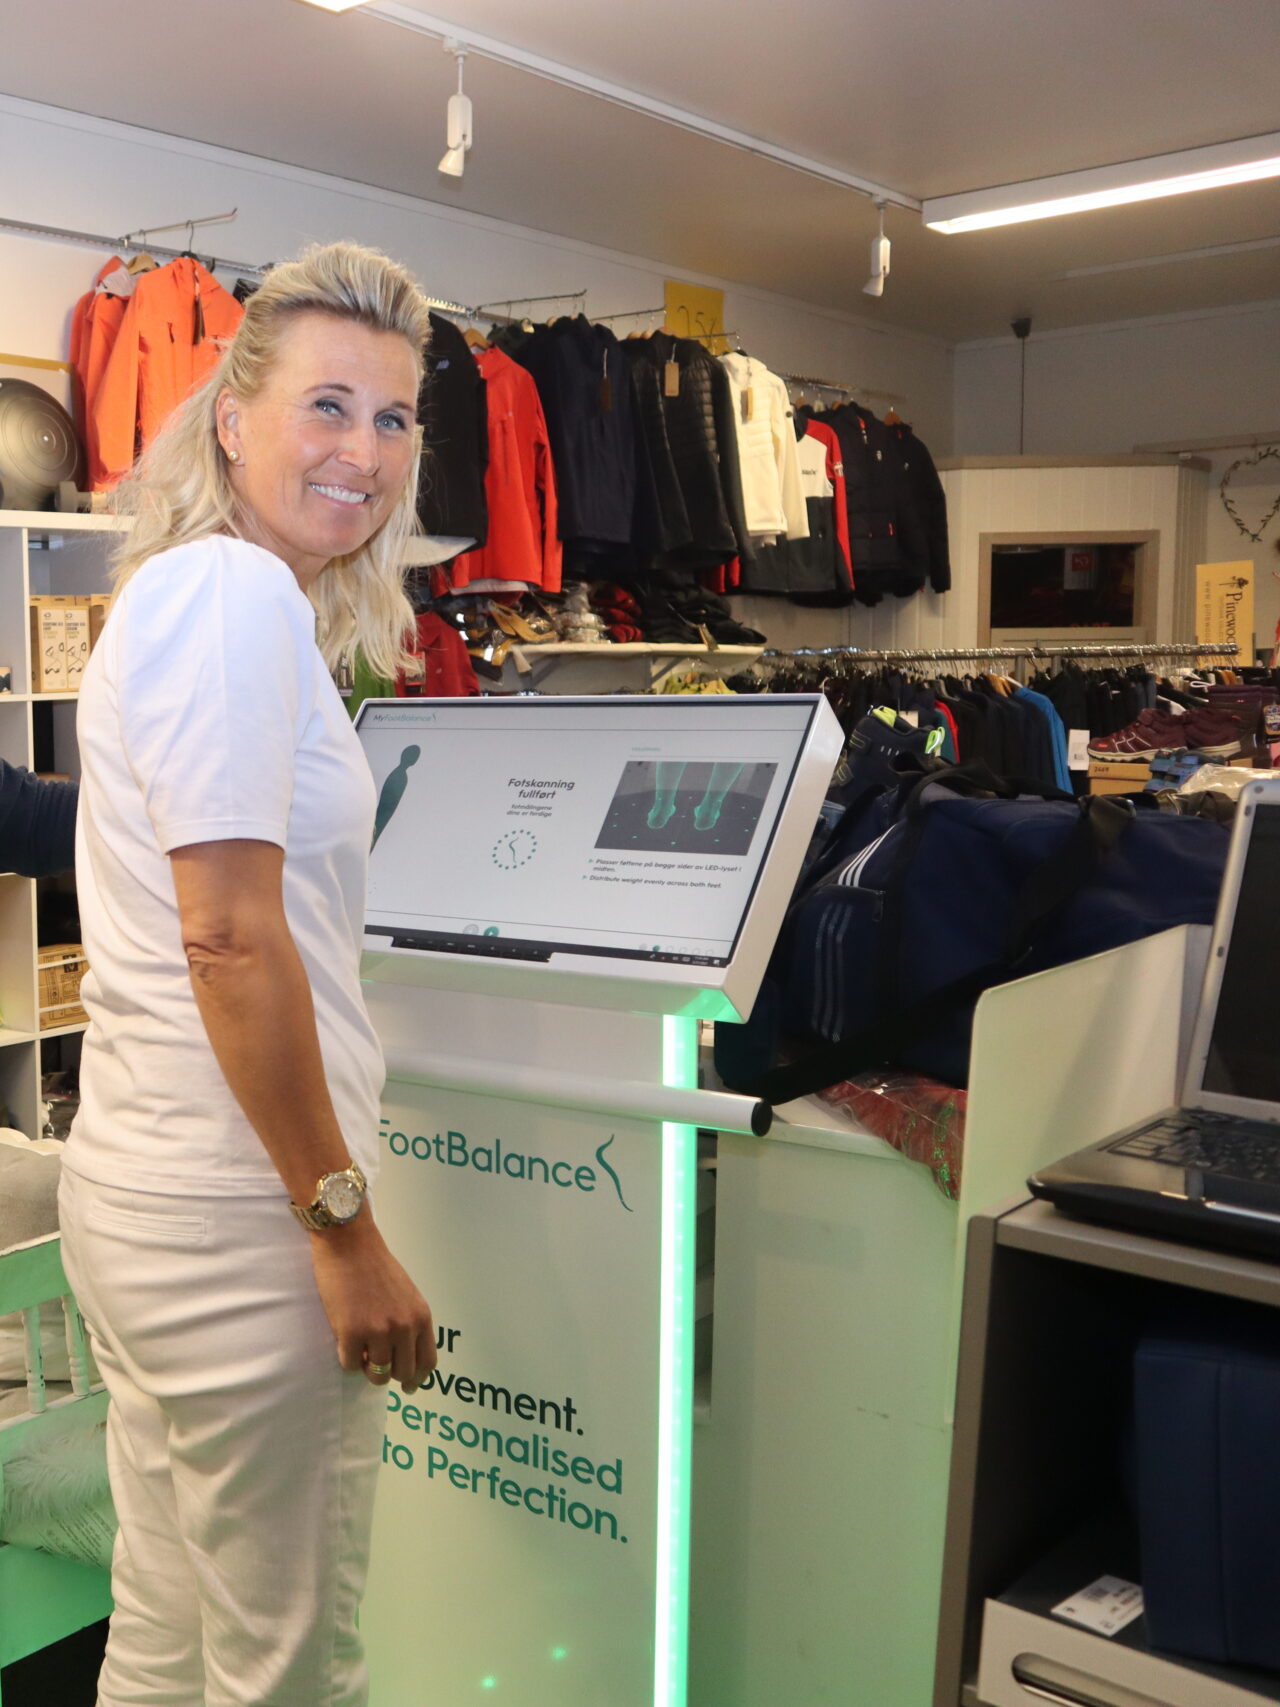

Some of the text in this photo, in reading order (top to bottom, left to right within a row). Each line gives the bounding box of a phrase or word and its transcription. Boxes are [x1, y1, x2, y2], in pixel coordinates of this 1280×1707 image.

[507, 778, 576, 791] Fotskanning
[518, 789, 556, 799] fullført
[418, 1368, 585, 1437] ovement.
[381, 1434, 629, 1544] to Perfection.
